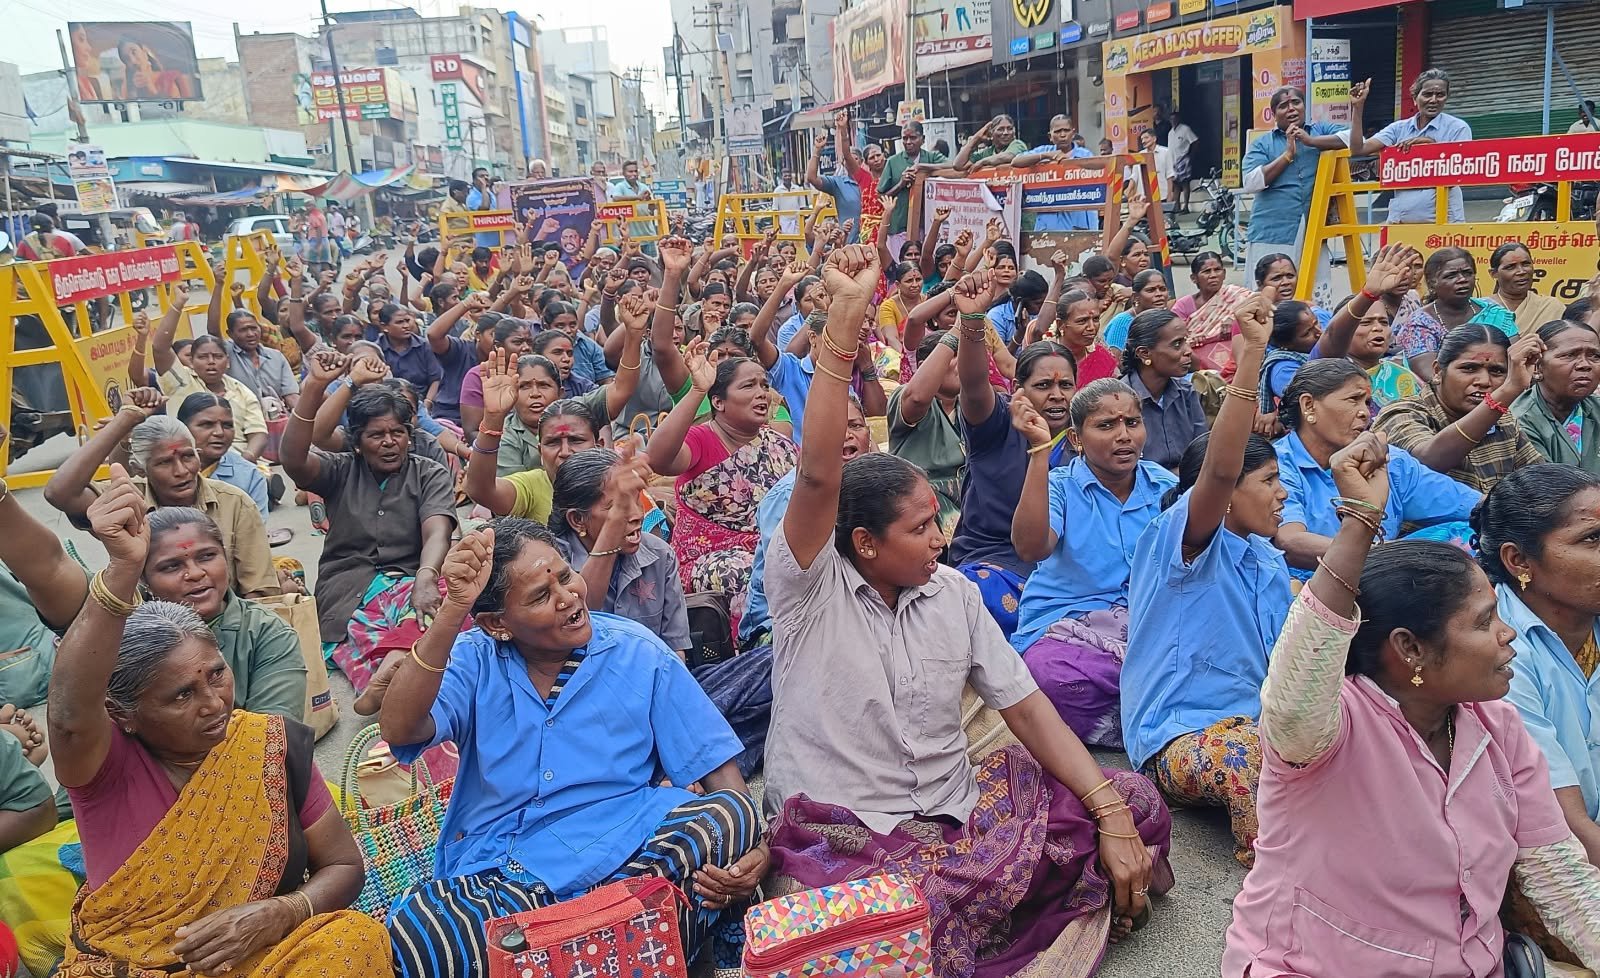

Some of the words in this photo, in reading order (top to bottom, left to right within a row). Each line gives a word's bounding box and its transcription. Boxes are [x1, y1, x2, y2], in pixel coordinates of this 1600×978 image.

[1133, 38, 1164, 60] MEGA
[1165, 29, 1202, 53] BLAST
[1203, 26, 1243, 47] OFFER
[433, 59, 458, 72] RD
[1315, 84, 1348, 98] ஜெராக்ஸ்
[1224, 159, 1239, 170] 10%
[1382, 152, 1500, 183] திருசெங்கோடு
[1507, 153, 1547, 175] நகர
[603, 207, 633, 217] POLICE
